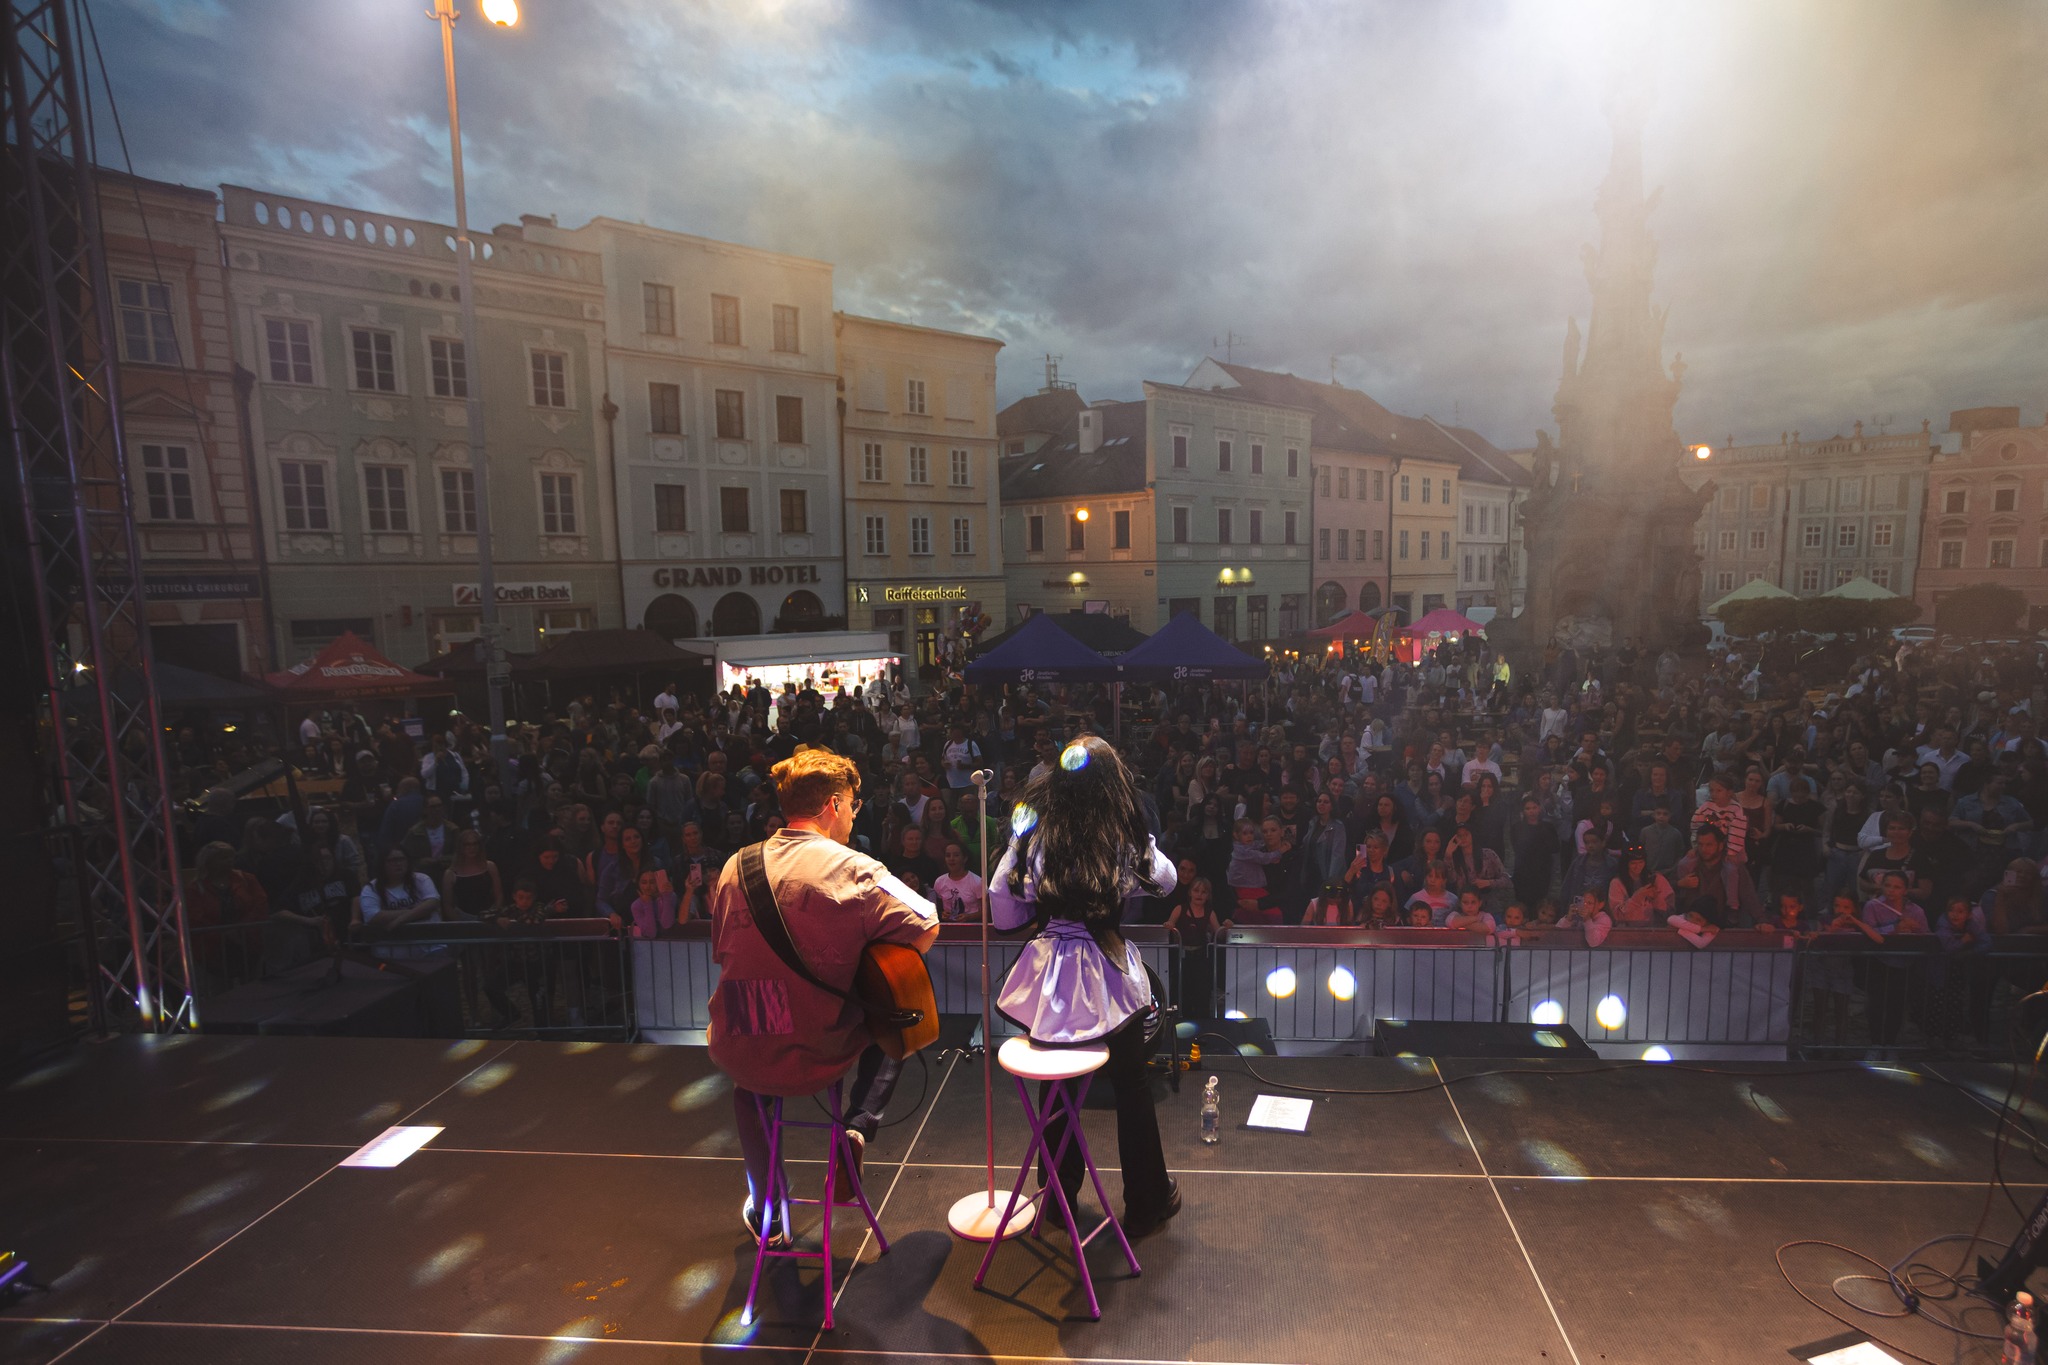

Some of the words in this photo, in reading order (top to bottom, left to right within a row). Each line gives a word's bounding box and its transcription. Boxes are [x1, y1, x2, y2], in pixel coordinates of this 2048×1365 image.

[653, 566, 742, 588] GRAND
[749, 565, 822, 586] HOTEL
[474, 586, 534, 601] UCredit
[537, 585, 570, 599] Bank
[885, 585, 967, 602] Raiffeisenbank
